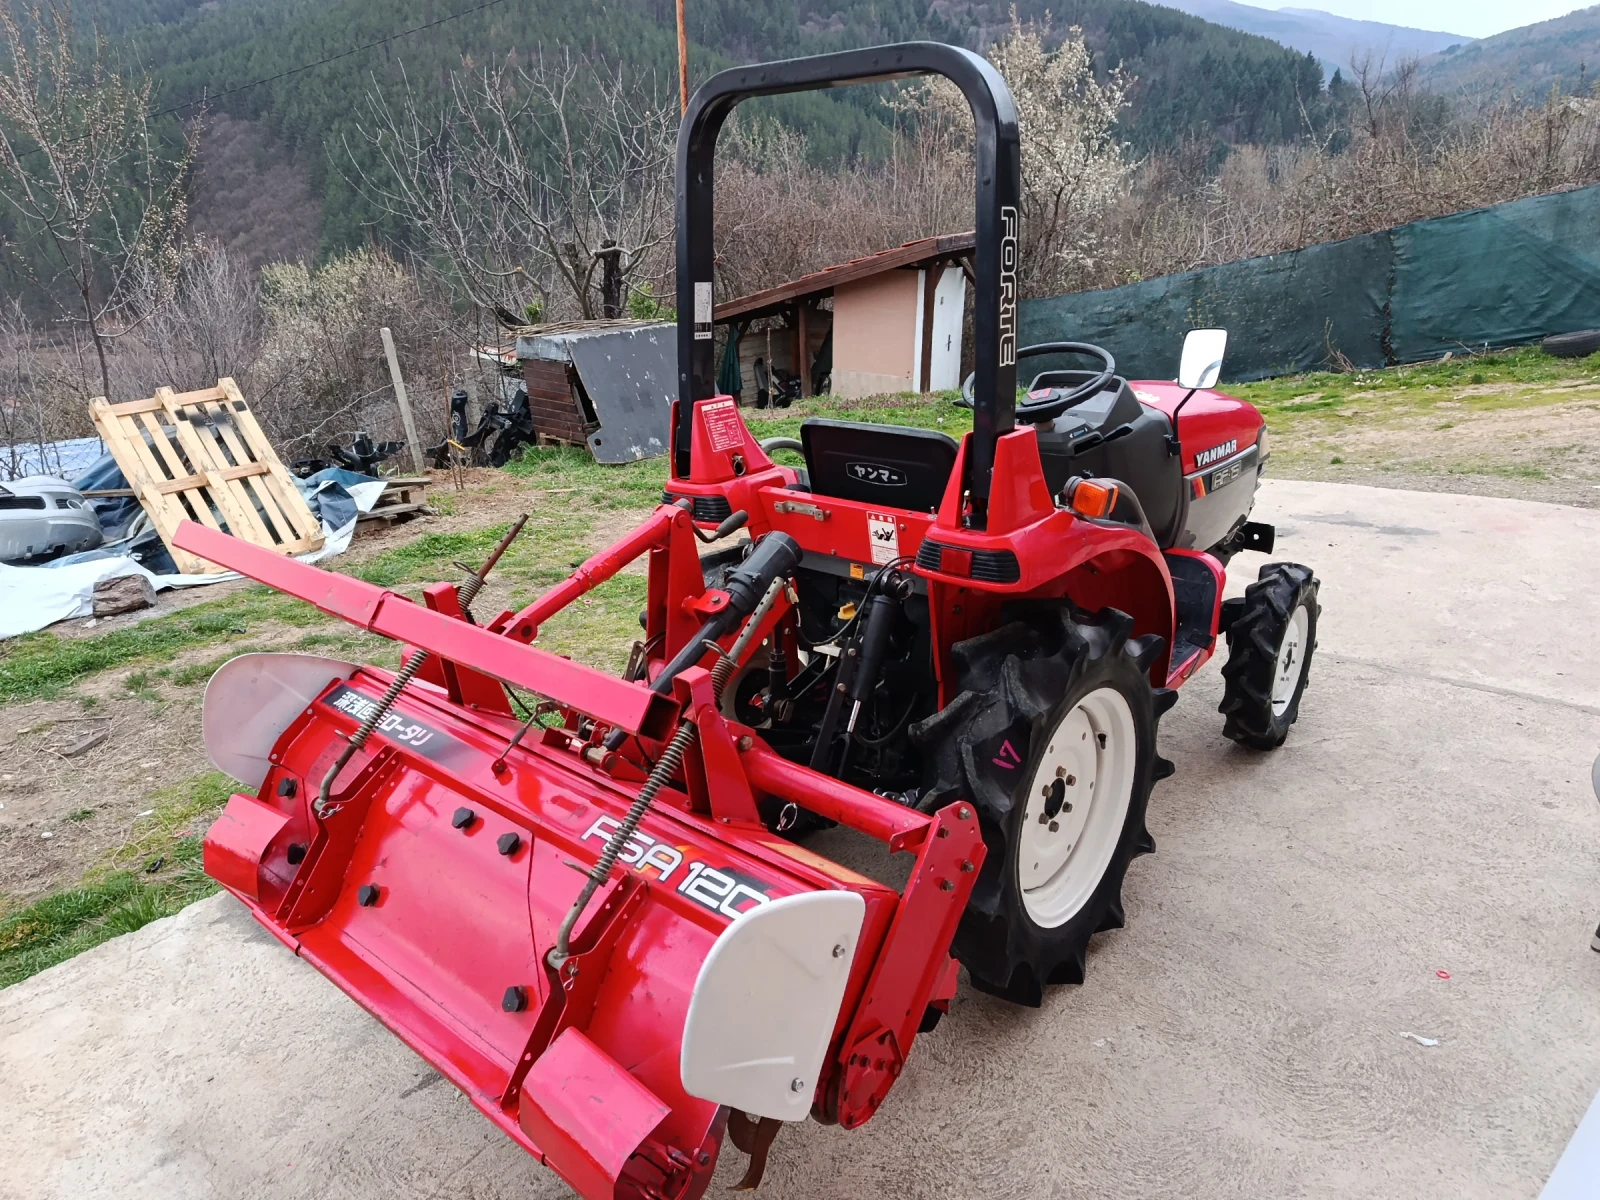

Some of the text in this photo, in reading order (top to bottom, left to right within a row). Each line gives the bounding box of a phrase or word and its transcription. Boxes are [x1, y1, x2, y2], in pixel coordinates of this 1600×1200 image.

[999, 206, 1018, 367] FORTE
[854, 465, 899, 482] ヤンマー
[1195, 439, 1237, 467] YANMAR
[678, 861, 770, 920] 120
